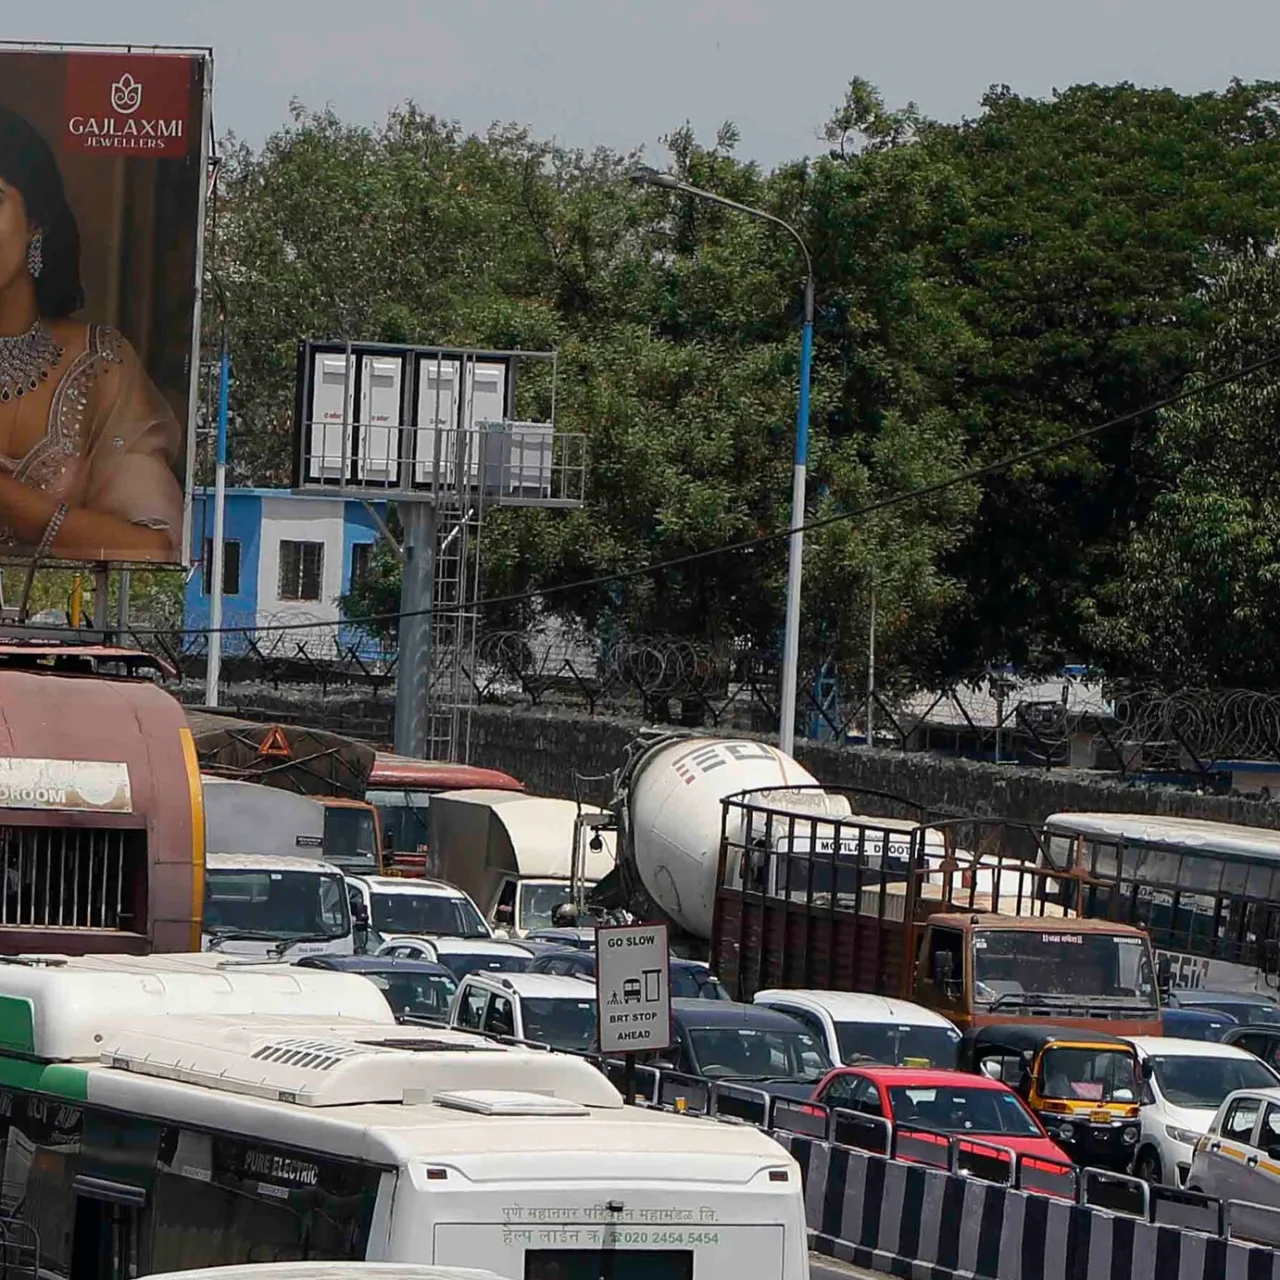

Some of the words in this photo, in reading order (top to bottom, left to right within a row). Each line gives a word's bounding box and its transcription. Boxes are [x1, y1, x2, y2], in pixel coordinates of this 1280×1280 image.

[69, 116, 183, 137] GAJLAXMI
[84, 136, 165, 149] JEWELLERS
[607, 938, 624, 948] GO
[626, 936, 655, 947] SLOW
[609, 1014, 629, 1024] BRT
[632, 1011, 658, 1022] STOP
[617, 1030, 651, 1041] AHEAD
[244, 1151, 270, 1175] PURE
[271, 1156, 319, 1186] ELECTRIC
[501, 1204, 522, 1222] पुणे
[528, 1206, 579, 1220] महानगर
[583, 1204, 636, 1222] परिवहन
[639, 1205, 693, 1222] महामंडळ
[698, 1205, 719, 1222] लि.
[501, 1225, 533, 1244] हेल्प
[539, 1224, 582, 1244] लाईन
[624, 1231, 648, 1244] 020
[651, 1232, 684, 1244] 2454
[687, 1232, 719, 1244] 5454
